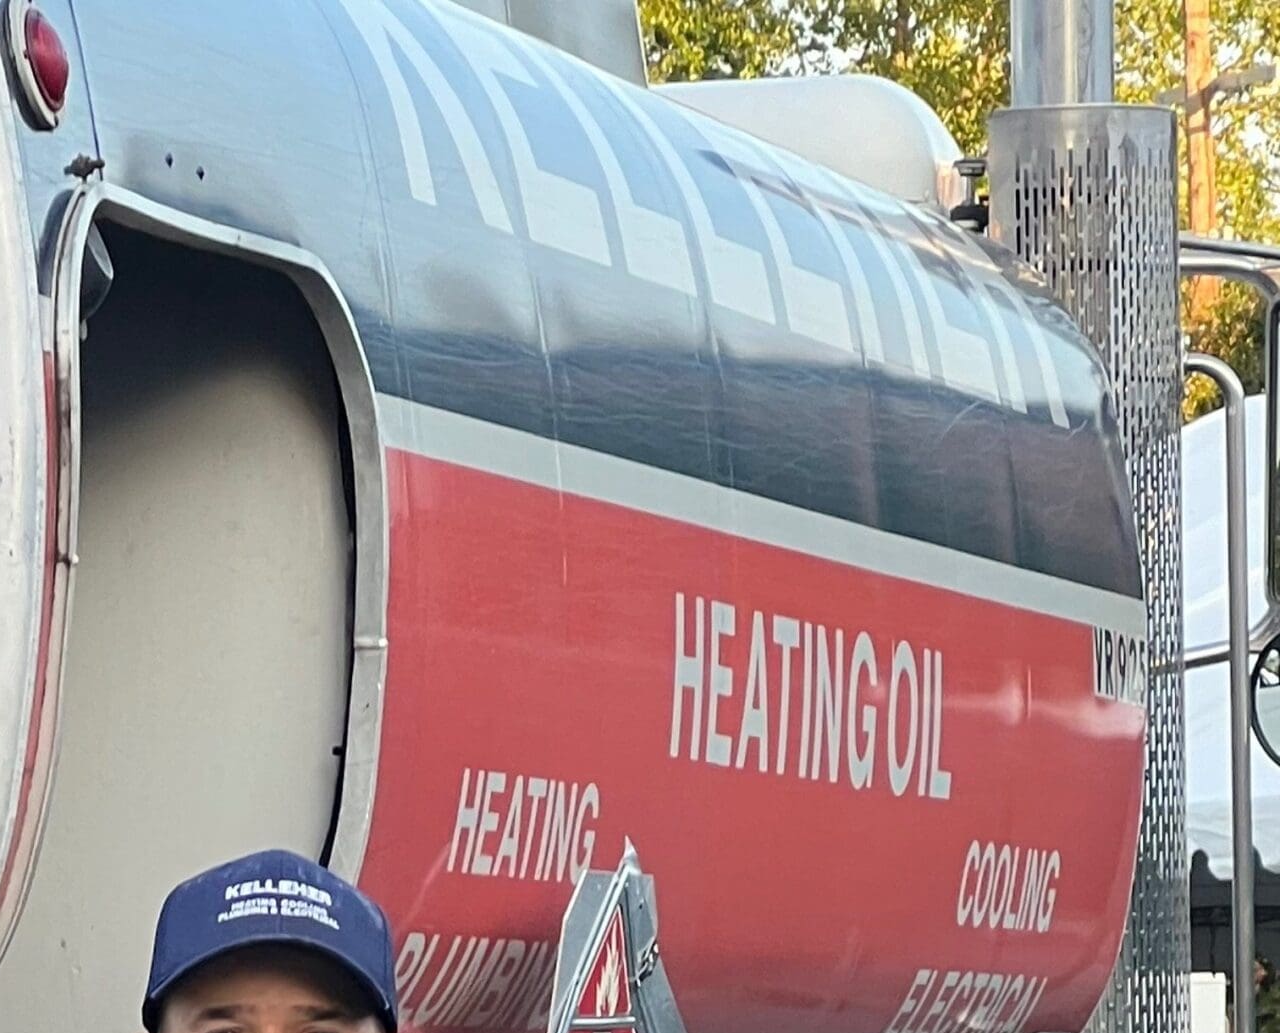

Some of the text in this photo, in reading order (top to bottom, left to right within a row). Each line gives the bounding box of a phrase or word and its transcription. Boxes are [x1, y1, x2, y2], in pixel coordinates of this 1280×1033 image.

[670, 592, 952, 800] HEATING OIL
[446, 767, 600, 887] HEATING
[225, 879, 332, 906] KELLEHER
[957, 839, 1061, 934] COOLING
